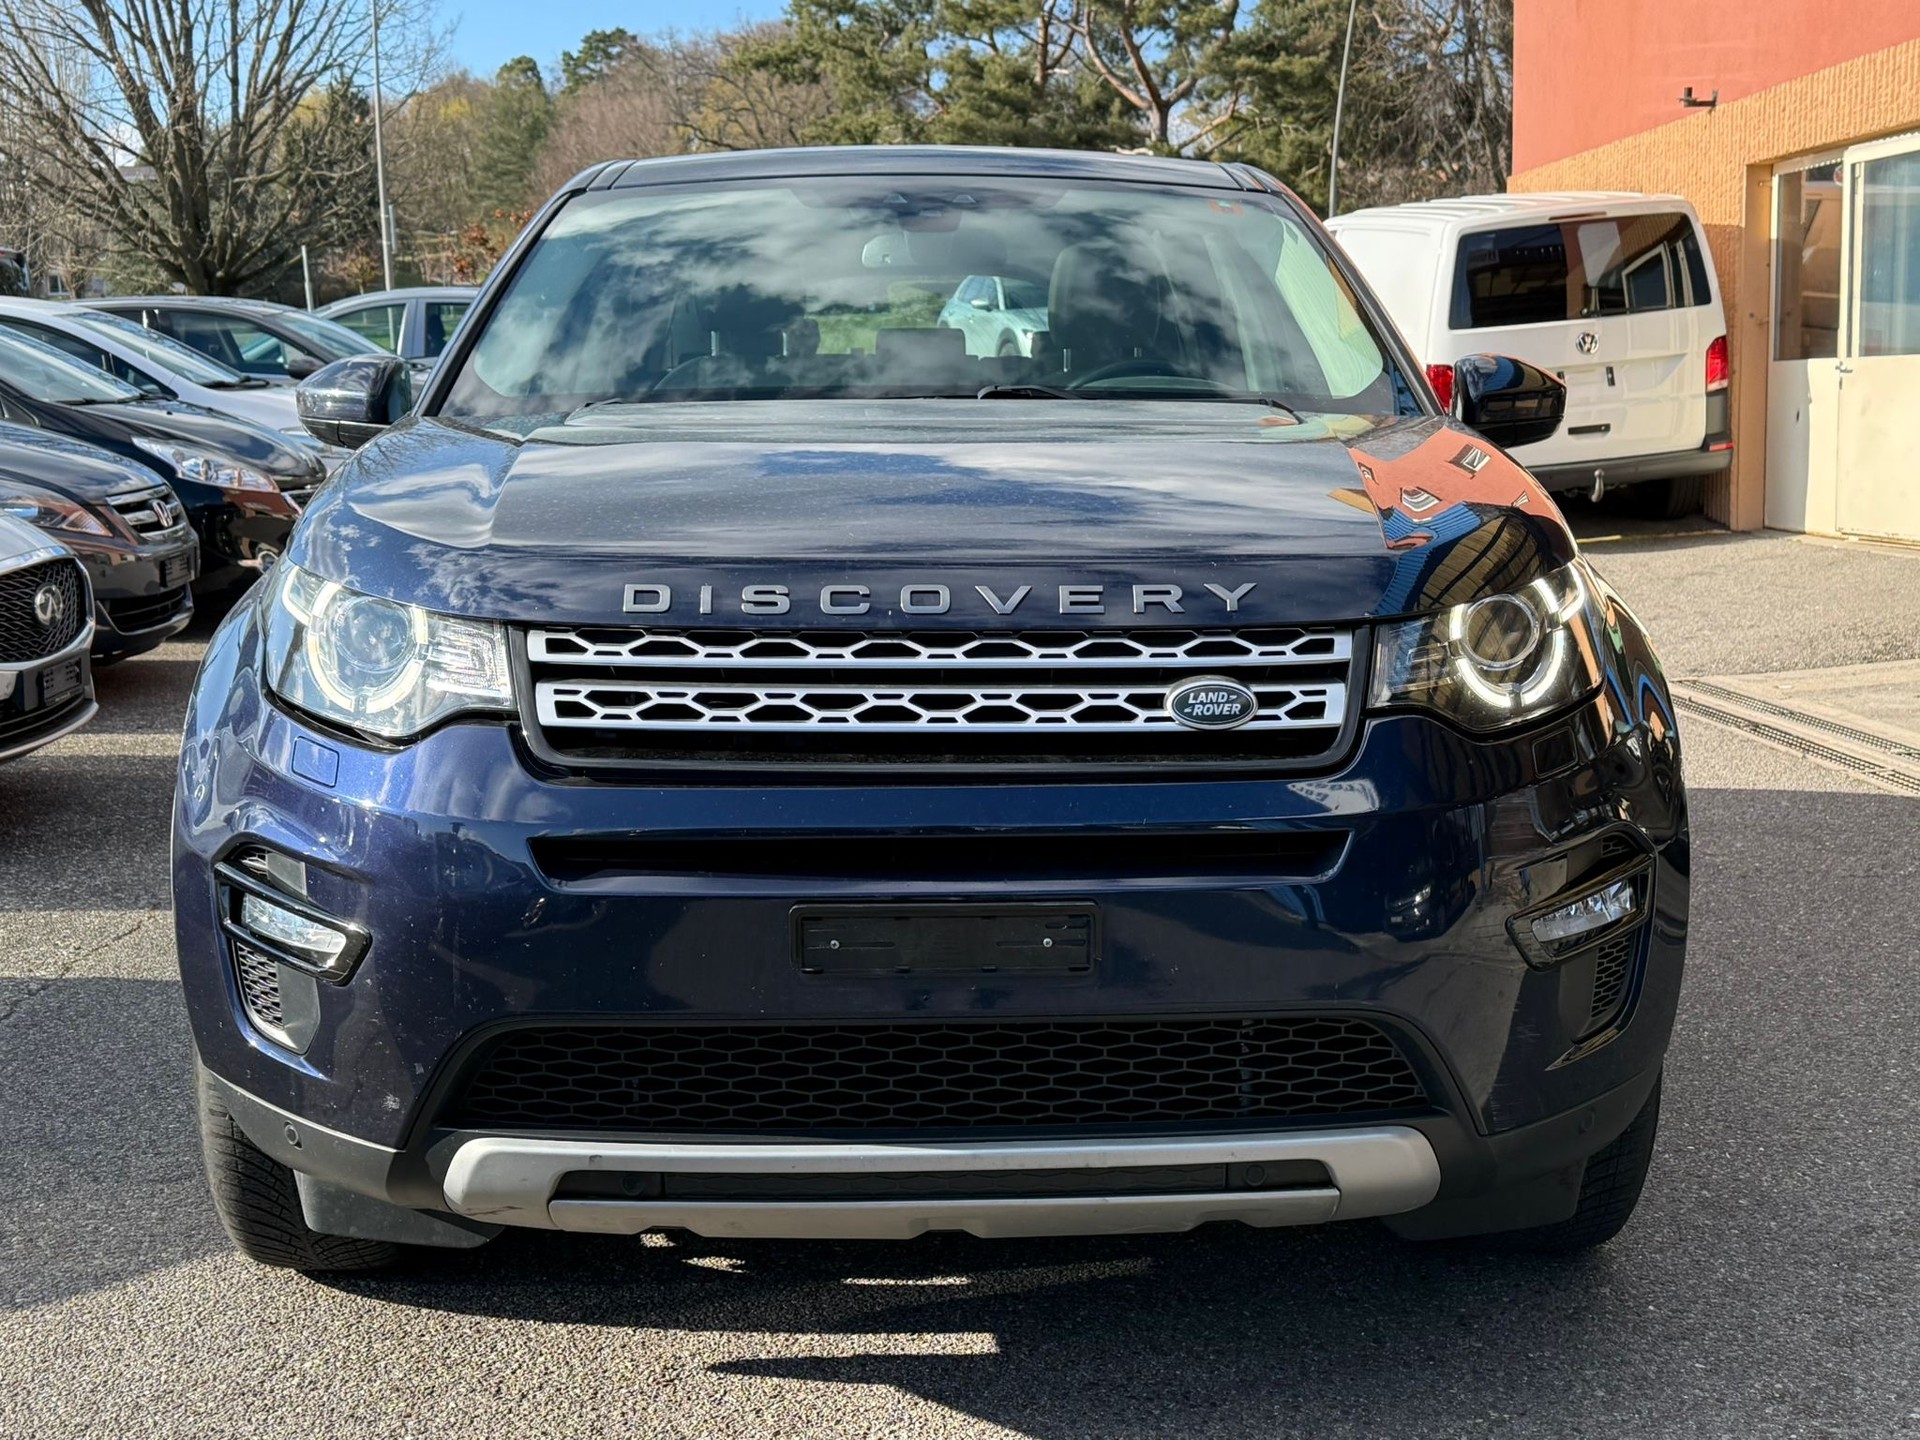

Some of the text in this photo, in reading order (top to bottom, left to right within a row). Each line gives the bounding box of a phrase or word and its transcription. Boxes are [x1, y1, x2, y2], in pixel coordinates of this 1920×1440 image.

[623, 583, 1257, 615] DISCOVERY
[1188, 692, 1228, 704] LAND
[1192, 703, 1241, 716] ROVER
